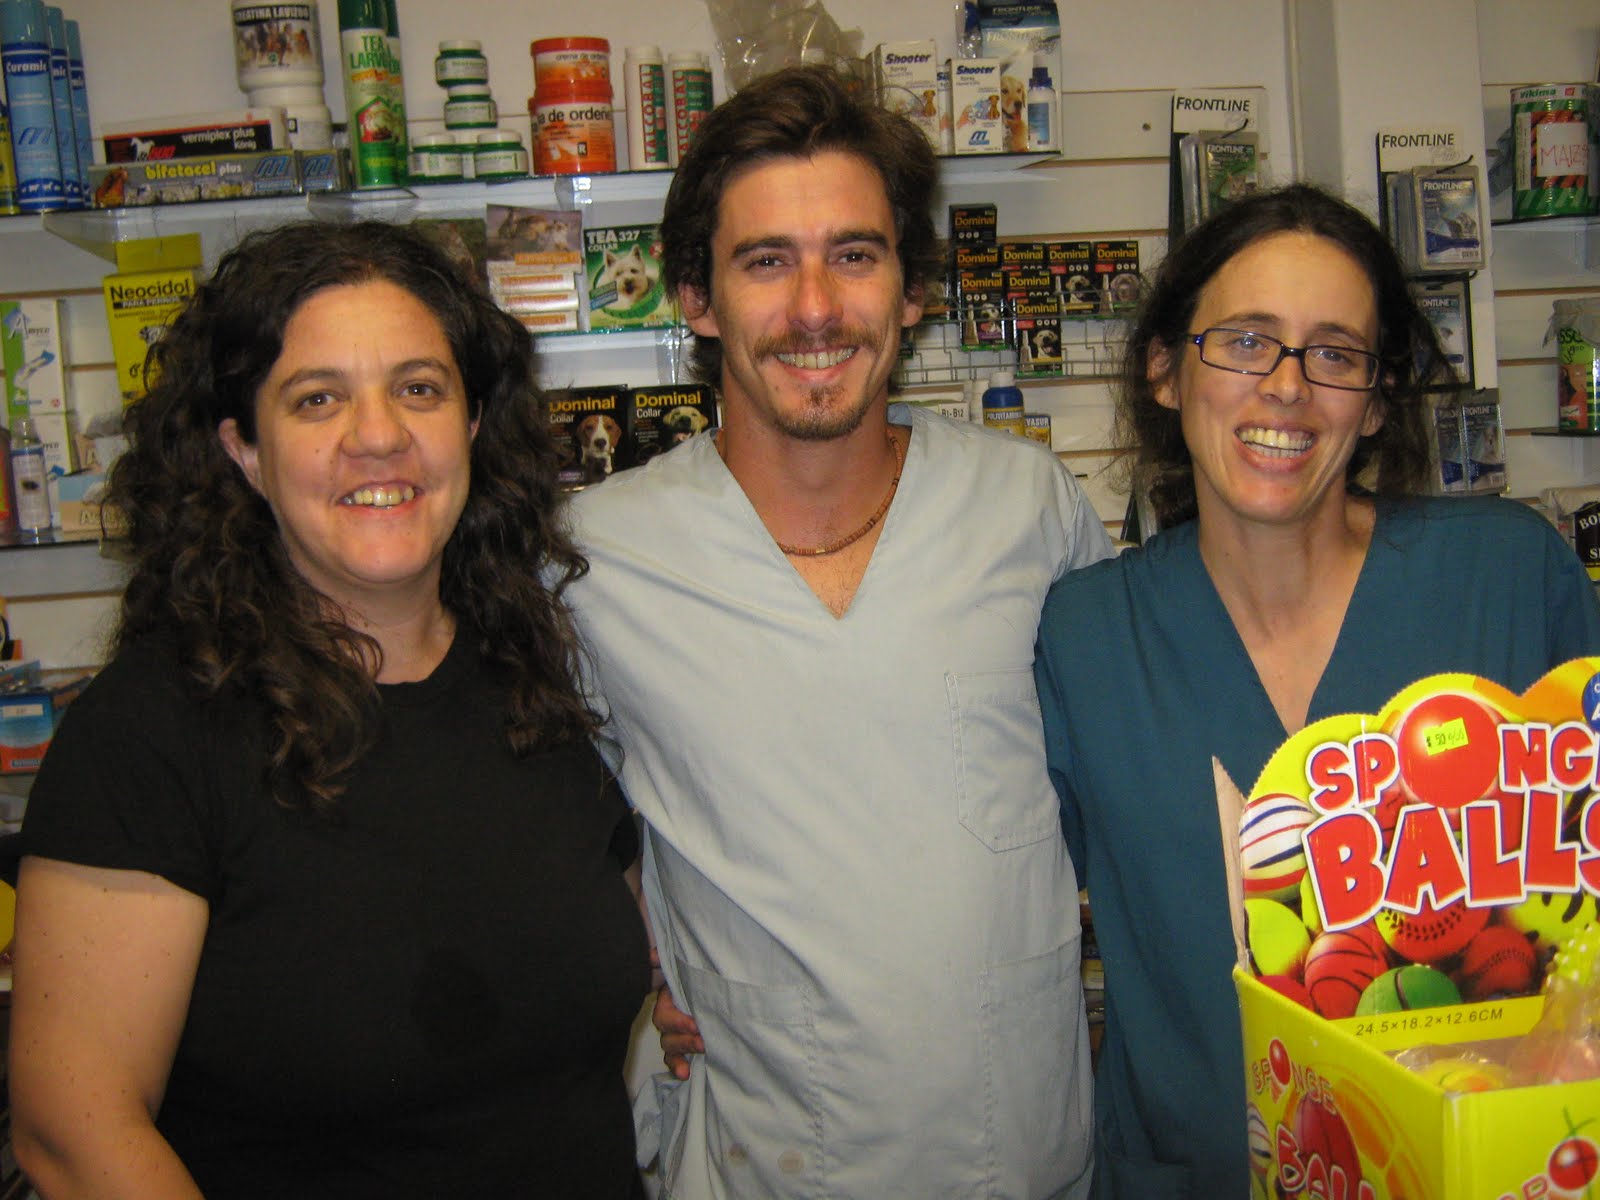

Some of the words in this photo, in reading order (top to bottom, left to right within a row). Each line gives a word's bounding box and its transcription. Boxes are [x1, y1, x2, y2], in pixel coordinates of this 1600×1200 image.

[956, 65, 995, 75] Shooter
[1176, 97, 1250, 112] FRONTLINE
[549, 109, 564, 123] de
[673, 71, 689, 154] ALCOBAL
[182, 130, 230, 144] vermiplex
[233, 128, 255, 141] plus
[1382, 133, 1456, 148] FRONTLINE
[220, 163, 242, 176] plus
[955, 215, 995, 227] Dominal
[587, 230, 619, 245] TEA
[619, 229, 641, 242] 327
[958, 253, 998, 265] Dominal
[1004, 249, 1044, 261] Dominal
[1050, 249, 1089, 261] Dominal
[1097, 247, 1137, 259] Dominal
[962, 276, 1002, 289] Dominal
[1010, 276, 1050, 288] Dominal
[110, 279, 190, 301] Neocidol
[1017, 303, 1057, 316] Dominal
[550, 396, 616, 413] Dominal
[636, 391, 702, 408] Dominal
[550, 414, 575, 425] Collar
[637, 409, 661, 420] Collar
[1252, 1040, 1337, 1116] SPONGE
